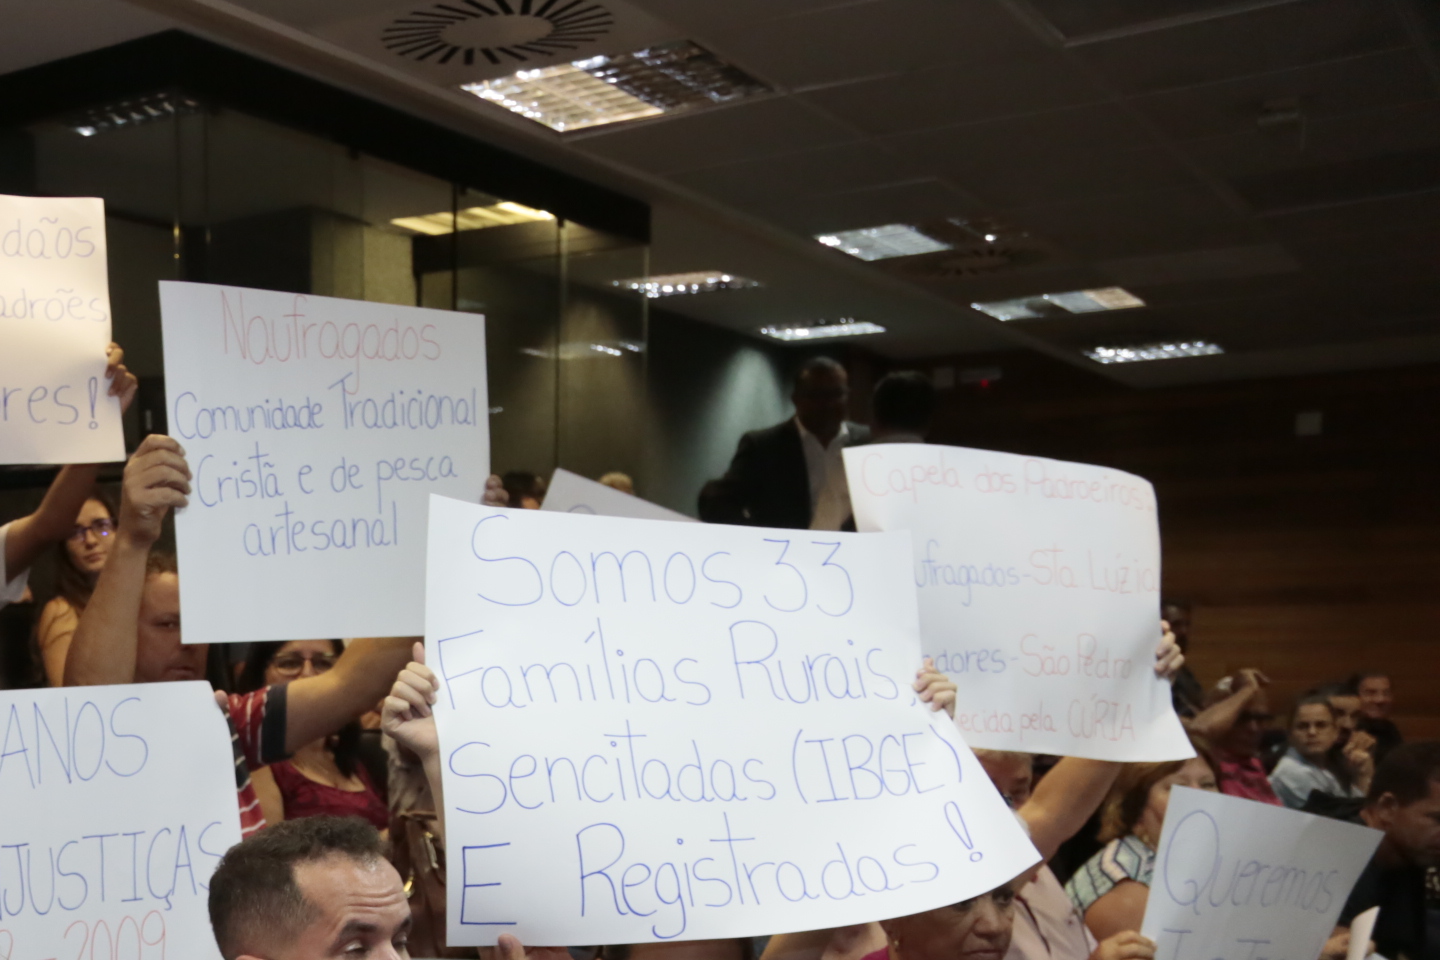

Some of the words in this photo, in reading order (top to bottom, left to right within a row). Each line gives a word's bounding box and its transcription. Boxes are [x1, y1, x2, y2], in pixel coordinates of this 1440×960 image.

[221, 289, 442, 395] Naufragados
[174, 391, 324, 440] Comunidade
[328, 372, 477, 430] Tradicional
[196, 441, 285, 508] Cristã
[297, 463, 314, 495] e
[330, 457, 364, 493] de
[376, 455, 458, 514] pesca
[861, 451, 964, 502] Capela
[975, 464, 1017, 494] dos
[243, 501, 398, 556] artesanal
[471, 515, 743, 608] Somos
[763, 538, 855, 617] 33
[438, 617, 712, 710] Famílias
[449, 719, 777, 815] Sencitadas
[793, 723, 963, 805] (IBGE)
[1020, 701, 1057, 743] pela
[460, 842, 518, 925] E
[576, 801, 984, 939] Registradas!
[1164, 809, 1340, 916] Queremos
